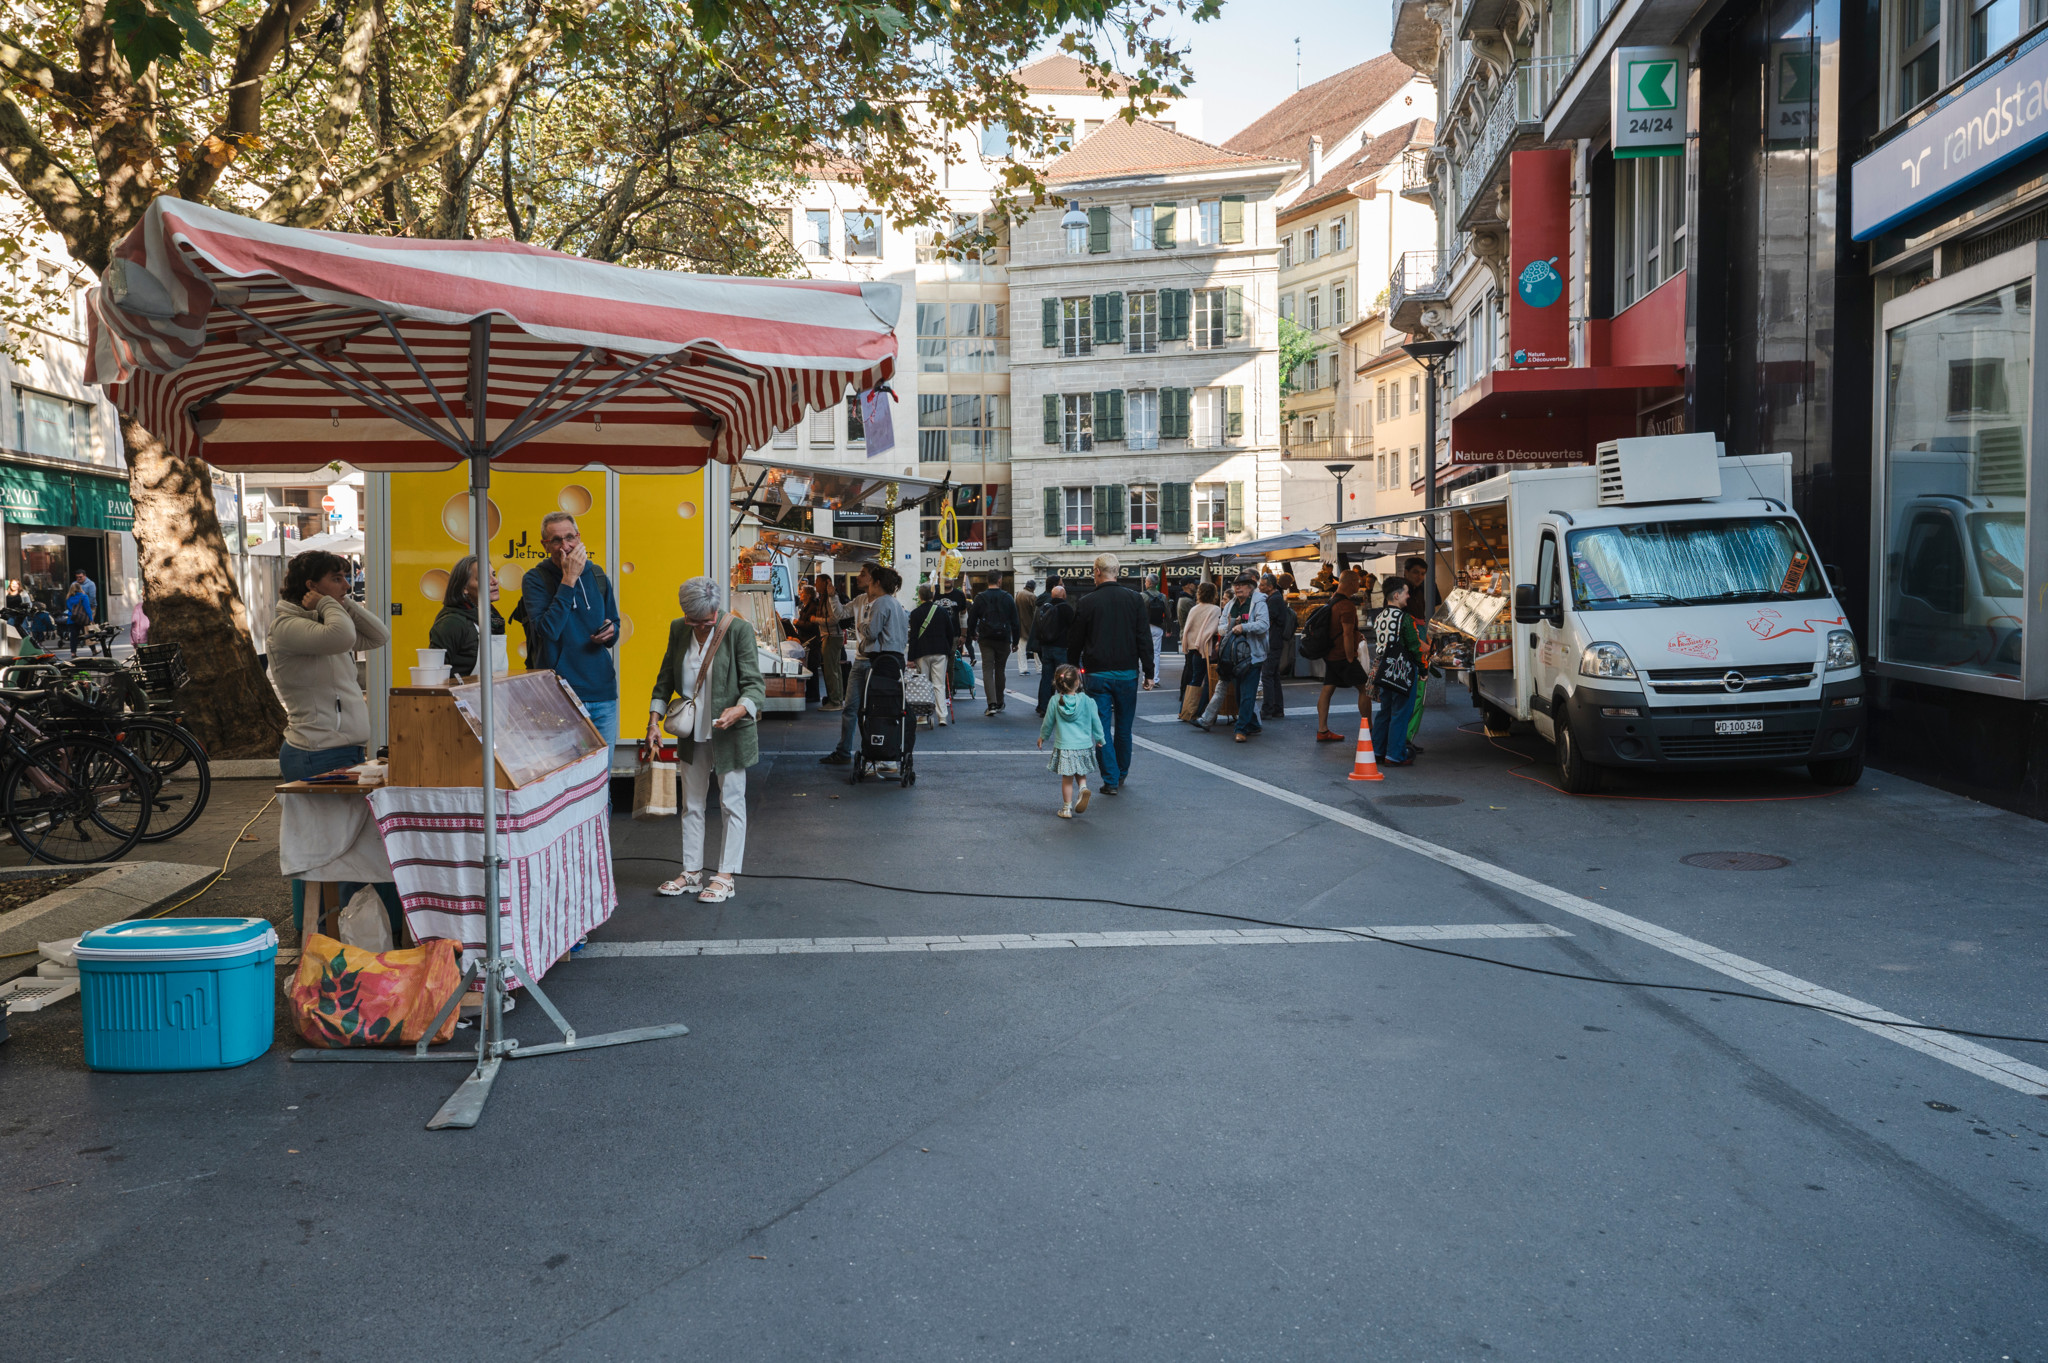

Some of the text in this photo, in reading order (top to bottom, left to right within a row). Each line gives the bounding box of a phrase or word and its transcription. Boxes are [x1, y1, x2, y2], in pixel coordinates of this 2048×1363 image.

[1629, 117, 1673, 133] 24/24
[1455, 448, 1584, 461] Nature & Découvertes
[107, 499, 134, 516] PAYO
[1003, 556, 1008, 566] 1
